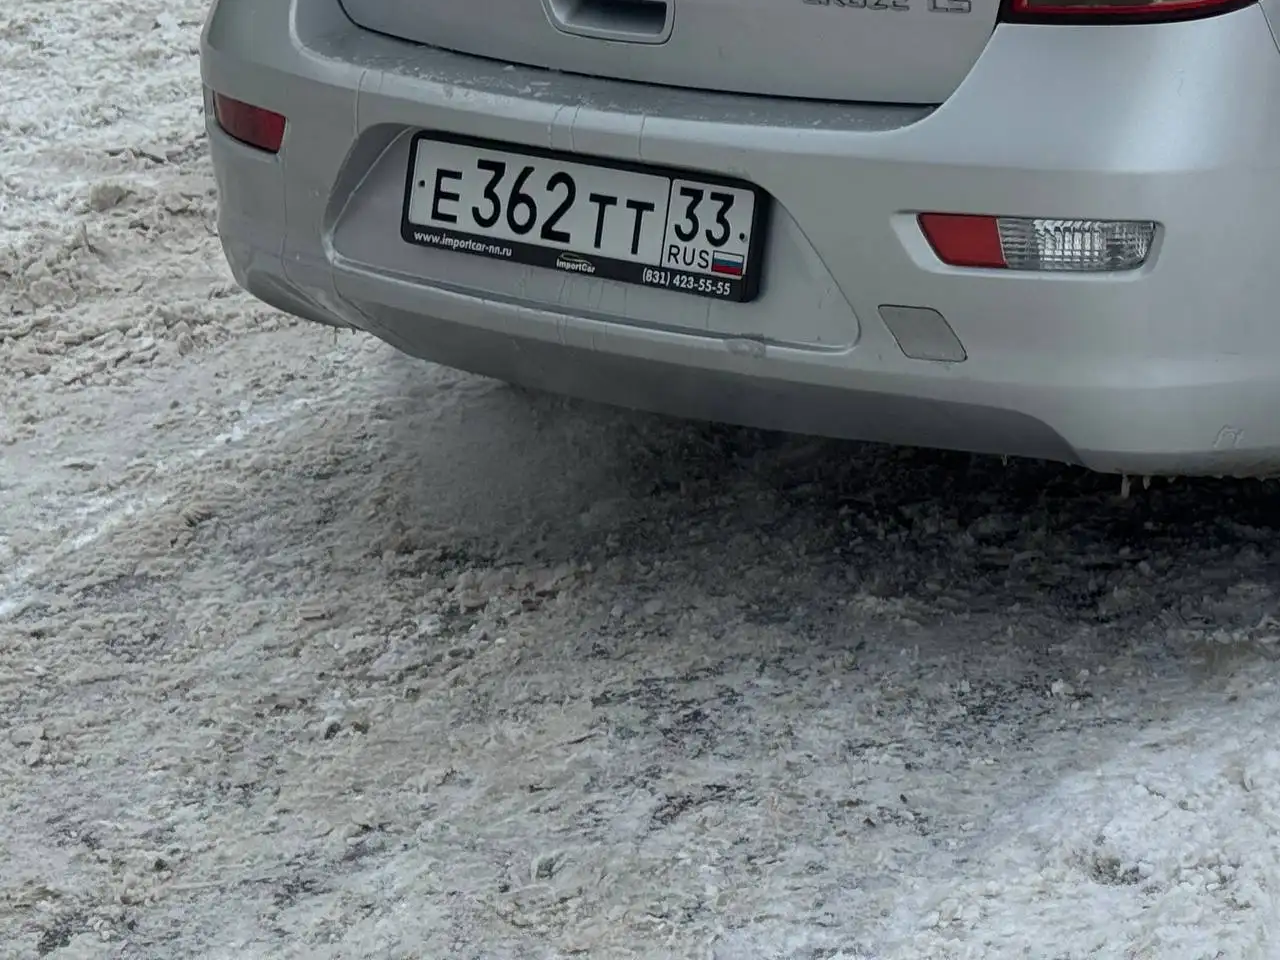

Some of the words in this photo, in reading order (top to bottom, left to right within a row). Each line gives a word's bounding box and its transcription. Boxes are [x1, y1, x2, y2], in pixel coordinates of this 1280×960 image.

[673, 186, 735, 248] 33
[413, 230, 513, 258] www.importcar-nn.ru
[666, 244, 710, 269] RUS
[555, 258, 596, 275] ImportCar
[642, 267, 671, 287] (831)
[672, 275, 731, 296] 423-55-55
